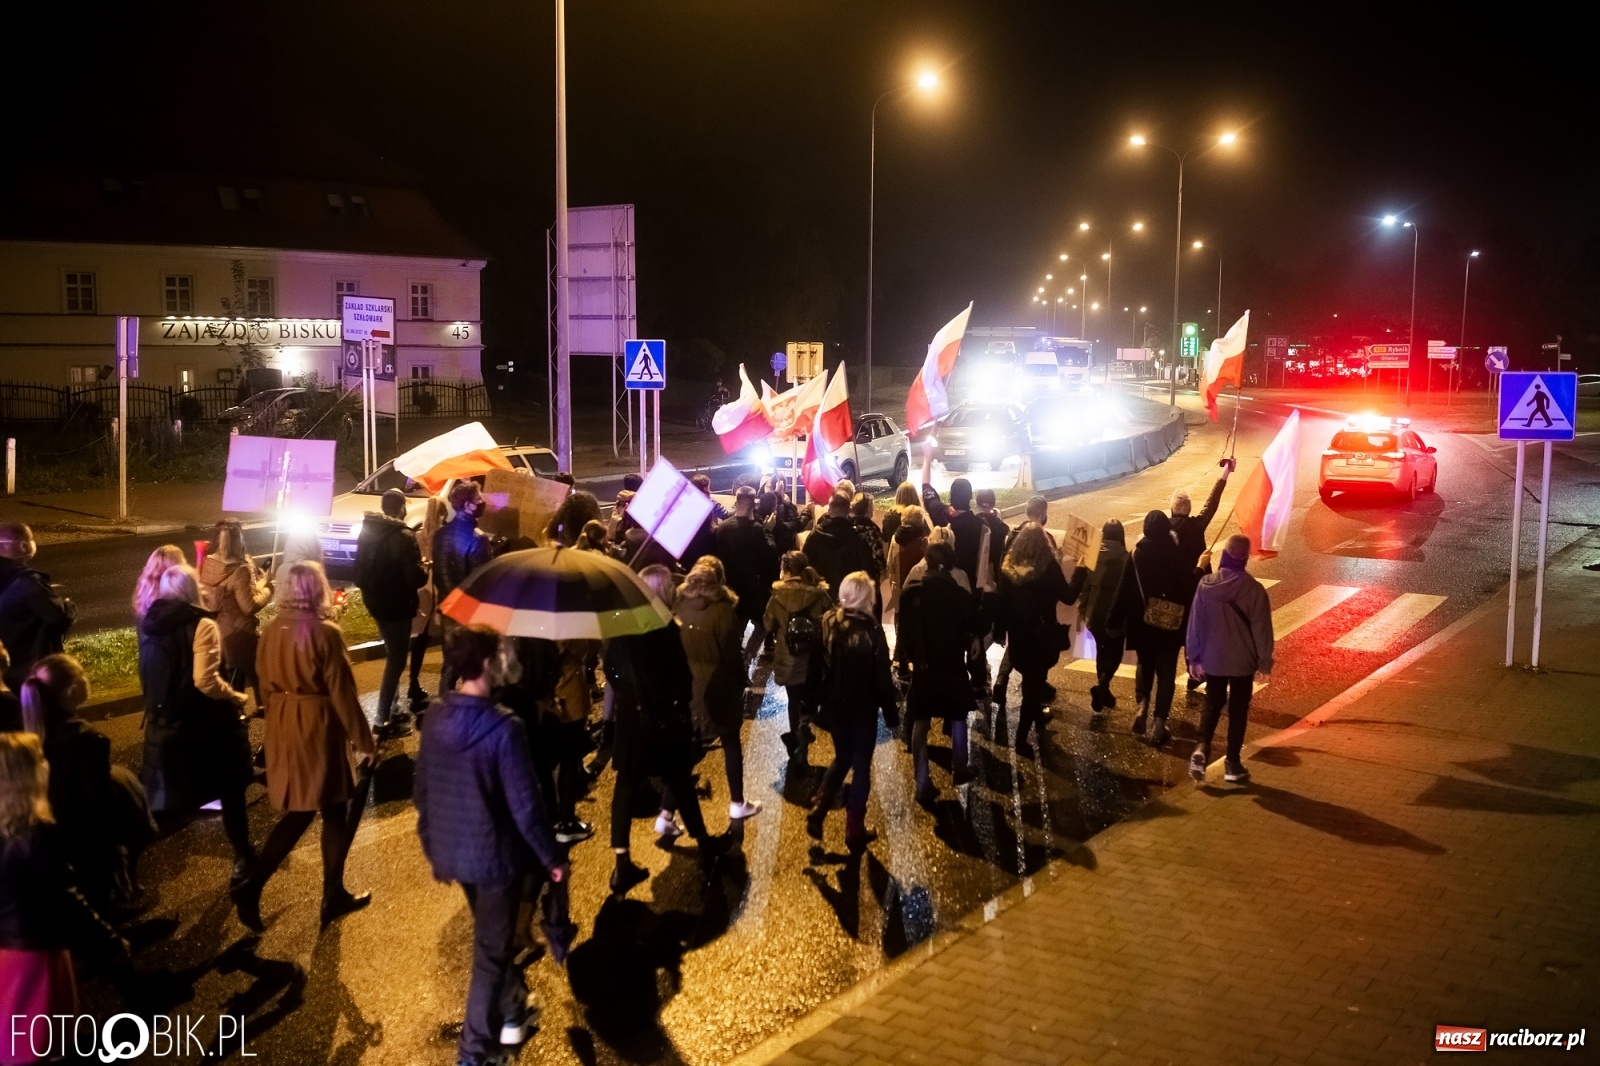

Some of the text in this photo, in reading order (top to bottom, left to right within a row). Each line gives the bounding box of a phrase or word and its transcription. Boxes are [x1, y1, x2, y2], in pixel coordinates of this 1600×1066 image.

[345, 302, 393, 314] ZAKŁAD SZKLARSKI
[161, 322, 247, 343] ZAJAZD
[278, 323, 342, 339] BISKU
[452, 325, 470, 340] 45
[1388, 346, 1409, 354] Rybnik
